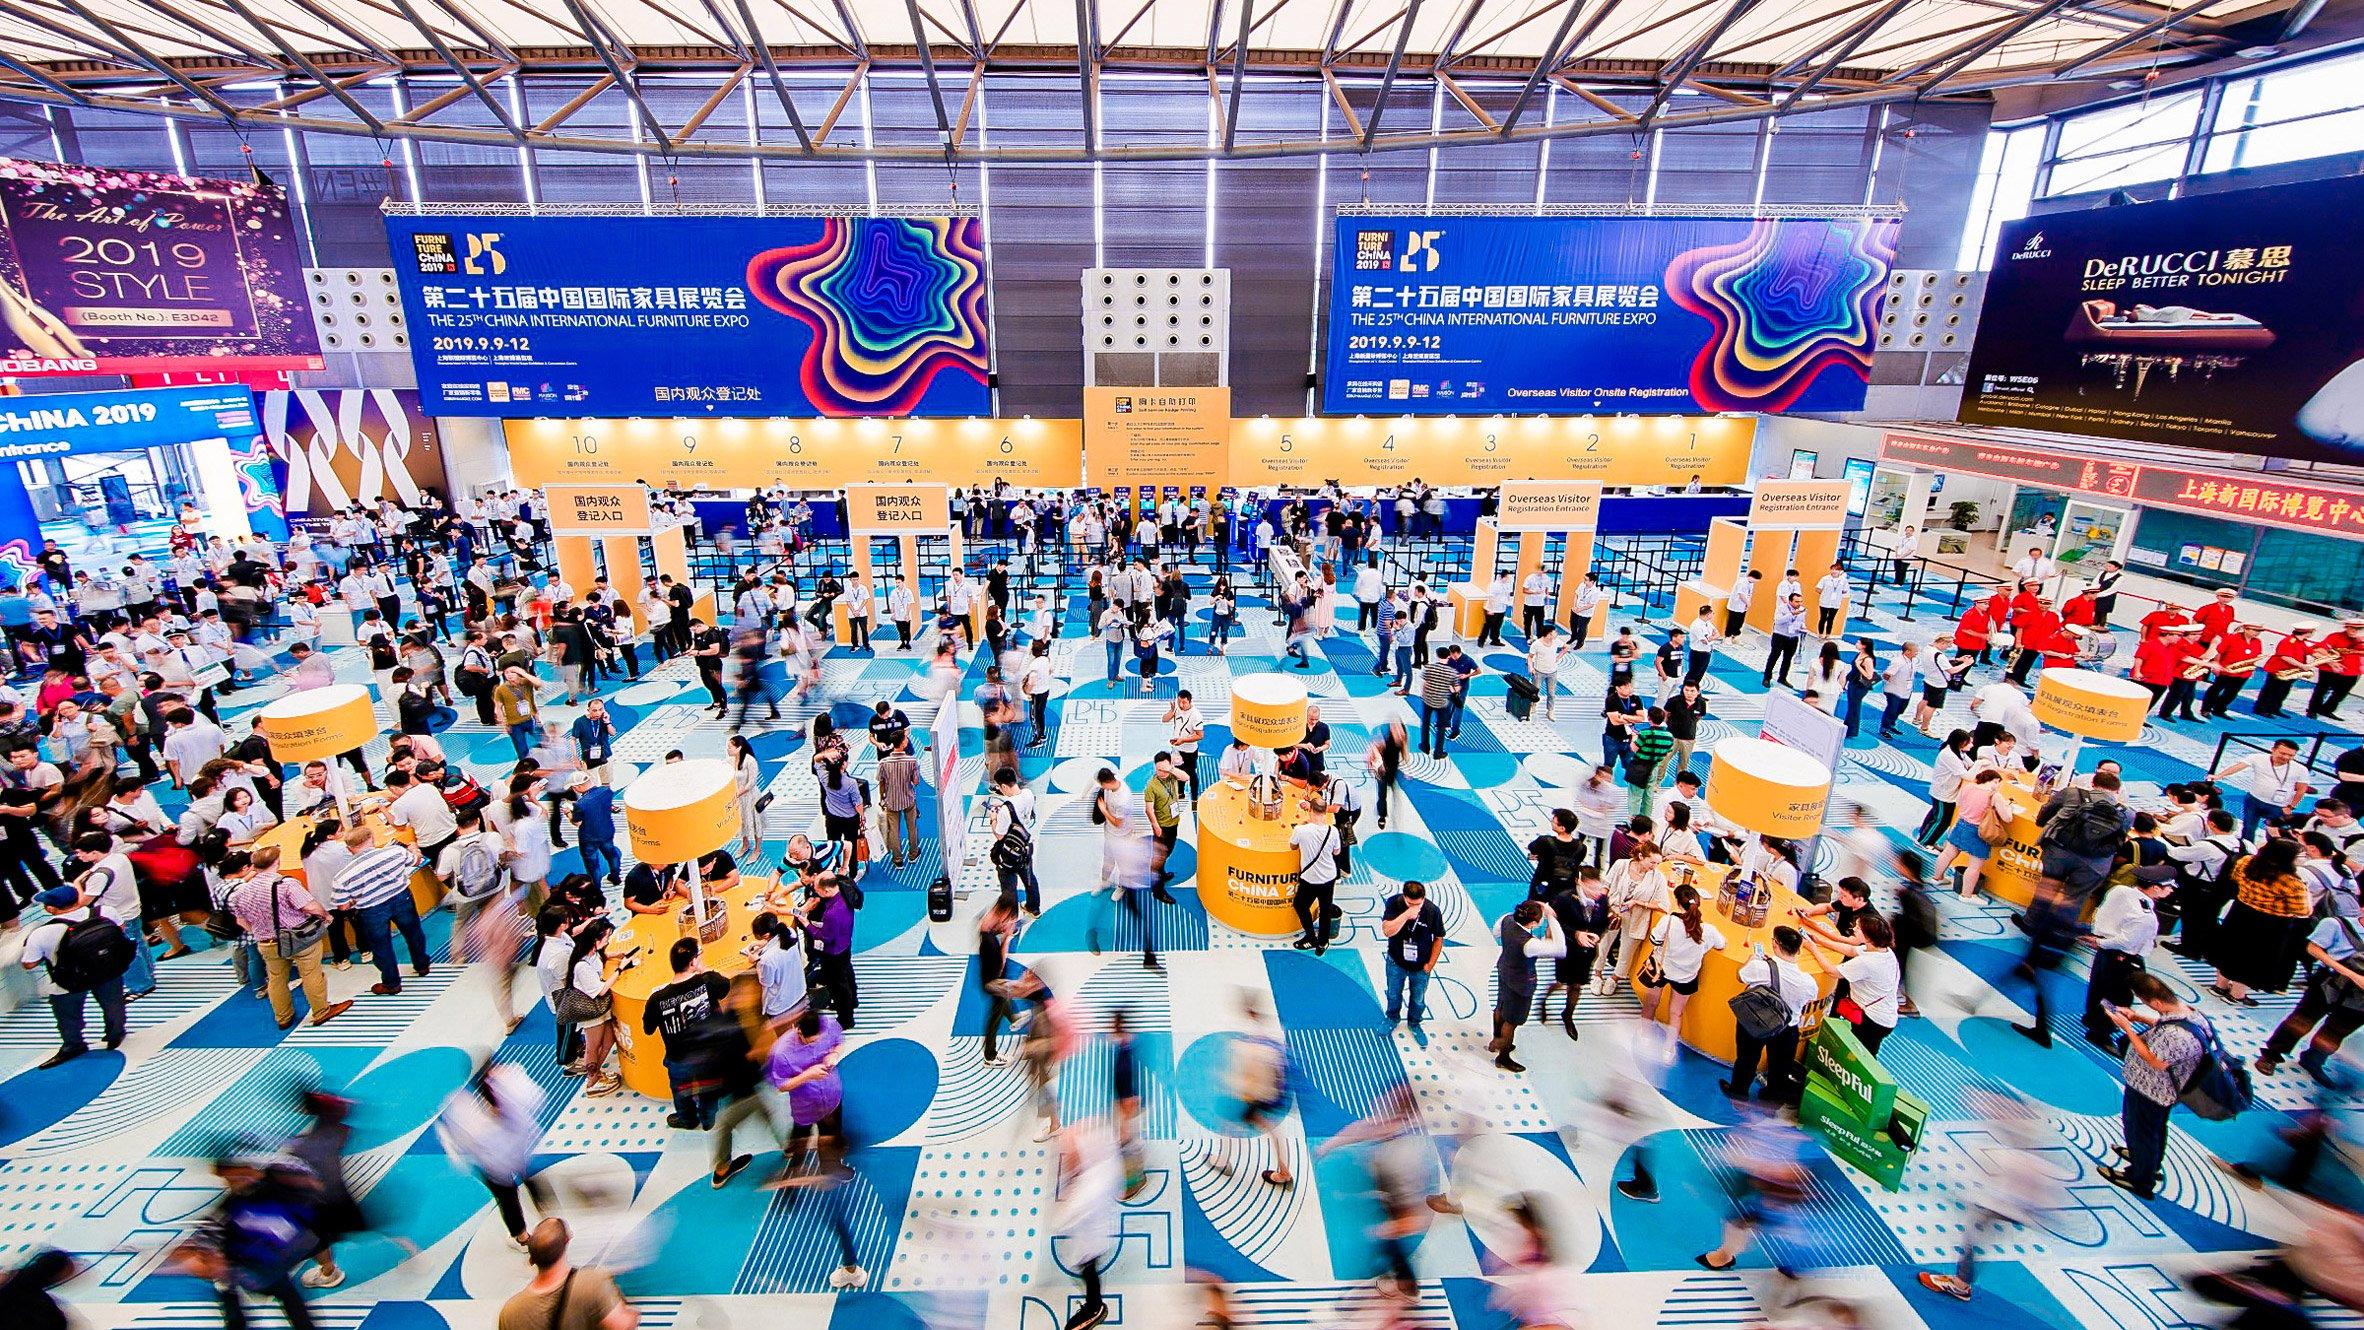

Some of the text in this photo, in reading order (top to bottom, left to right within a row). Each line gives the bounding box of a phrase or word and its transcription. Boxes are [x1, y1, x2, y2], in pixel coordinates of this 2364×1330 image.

[21, 202, 223, 233] The Art of Power
[415, 235, 446, 245] FURNI
[1358, 232, 1388, 242] FURNI
[58, 236, 206, 268] 2019
[418, 244, 443, 254] TURE
[1358, 241, 1382, 250] TURE
[1400, 231, 1440, 272] 25
[465, 233, 505, 274] 25
[2012, 249, 2051, 260] DeRUCCI
[420, 263, 443, 273] 2019
[1356, 260, 1379, 270] 2019
[2083, 245, 2293, 280] DeRUCCI 慕思
[70, 271, 215, 301] STYLE
[2081, 269, 2289, 292] SLEEP BETTER TONIGHT
[422, 285, 747, 310] 第二十五届中国国际家具展览会
[1351, 285, 1660, 309] 第二十五届中国国际家具展览会
[82, 312, 133, 323] (Booth
[172, 314, 218, 323] E3D42
[428, 315, 455, 327] THE
[485, 315, 527, 327] CHINA
[530, 315, 635, 327] INTERNATIONAL
[638, 315, 711, 327] FURNITURE
[714, 315, 749, 328] EXPO
[1351, 313, 1375, 325] THE
[1405, 313, 1445, 325] CHINA
[1448, 312, 1549, 325] INTERNATIONAL
[1551, 312, 1621, 325] FURNITURE
[1623, 312, 1657, 325] EXPO
[433, 337, 530, 351] 2019.9.9-12
[1349, 335, 1441, 349] 2019.9.9-12
[655, 387, 762, 402] 国内观众登记处
[1507, 387, 1689, 398] Overseas Visitor Onsite Registration
[92, 402, 156, 426] 2019
[573, 436, 597, 454] 10
[684, 436, 696, 454] 9
[789, 436, 802, 454] 8
[892, 436, 902, 454] 7
[1000, 436, 1013, 454] 6
[1280, 434, 1292, 452] 5
[1382, 434, 1395, 452] 4
[1484, 434, 1496, 452] 3
[1586, 433, 1599, 451] 2
[1690, 433, 1696, 450] 1
[574, 495, 621, 507] 国内观众
[875, 495, 922, 507] 国内观众
[1508, 493, 1591, 504] Overseas Visitor
[1761, 491, 1842, 502] Overseas Visitor
[576, 509, 623, 521] 登记入口
[877, 509, 923, 521] 登记入口
[1507, 504, 1590, 514] Registration Entrance
[1760, 503, 1840, 512] Registration Entrance
[1772, 811, 1802, 821] Visitor
[1817, 1045, 1873, 1104] SleepFul
[1820, 1115, 1860, 1145] SleepFul
